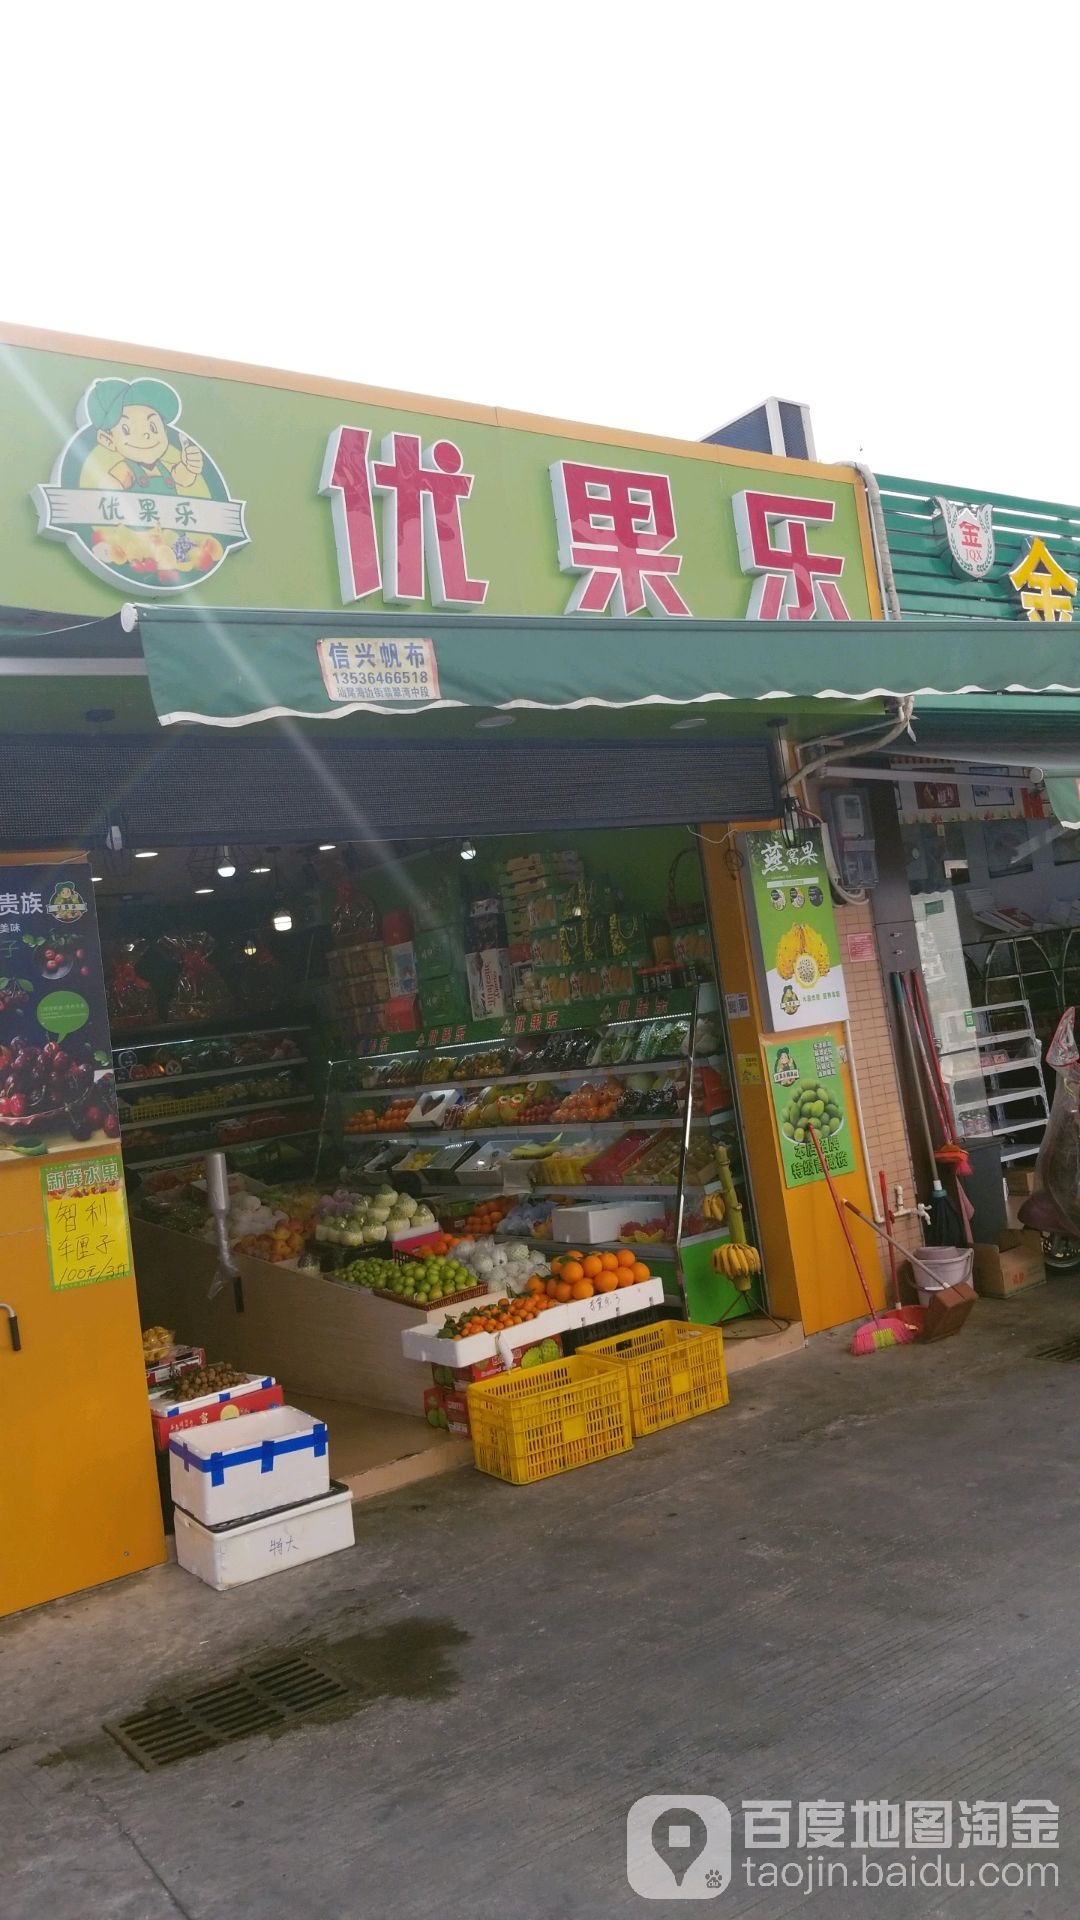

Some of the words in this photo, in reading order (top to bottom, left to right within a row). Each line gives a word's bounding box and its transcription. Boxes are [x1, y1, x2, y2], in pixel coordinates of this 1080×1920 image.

[98, 496, 197, 526] 优果乐
[320, 424, 852, 621] 优果乐
[958, 520, 983, 548] 金
[965, 548, 982, 562] JQX
[328, 642, 426, 669] 信兴帆布
[332, 671, 429, 685] 13536466518
[0, 891, 43, 916] 贵族
[514, 1011, 559, 1033] 优果乐
[46, 1162, 119, 1192] 新鲜水果
[55, 1197, 108, 1233] 智利
[269, 1535, 300, 1557] 特大
